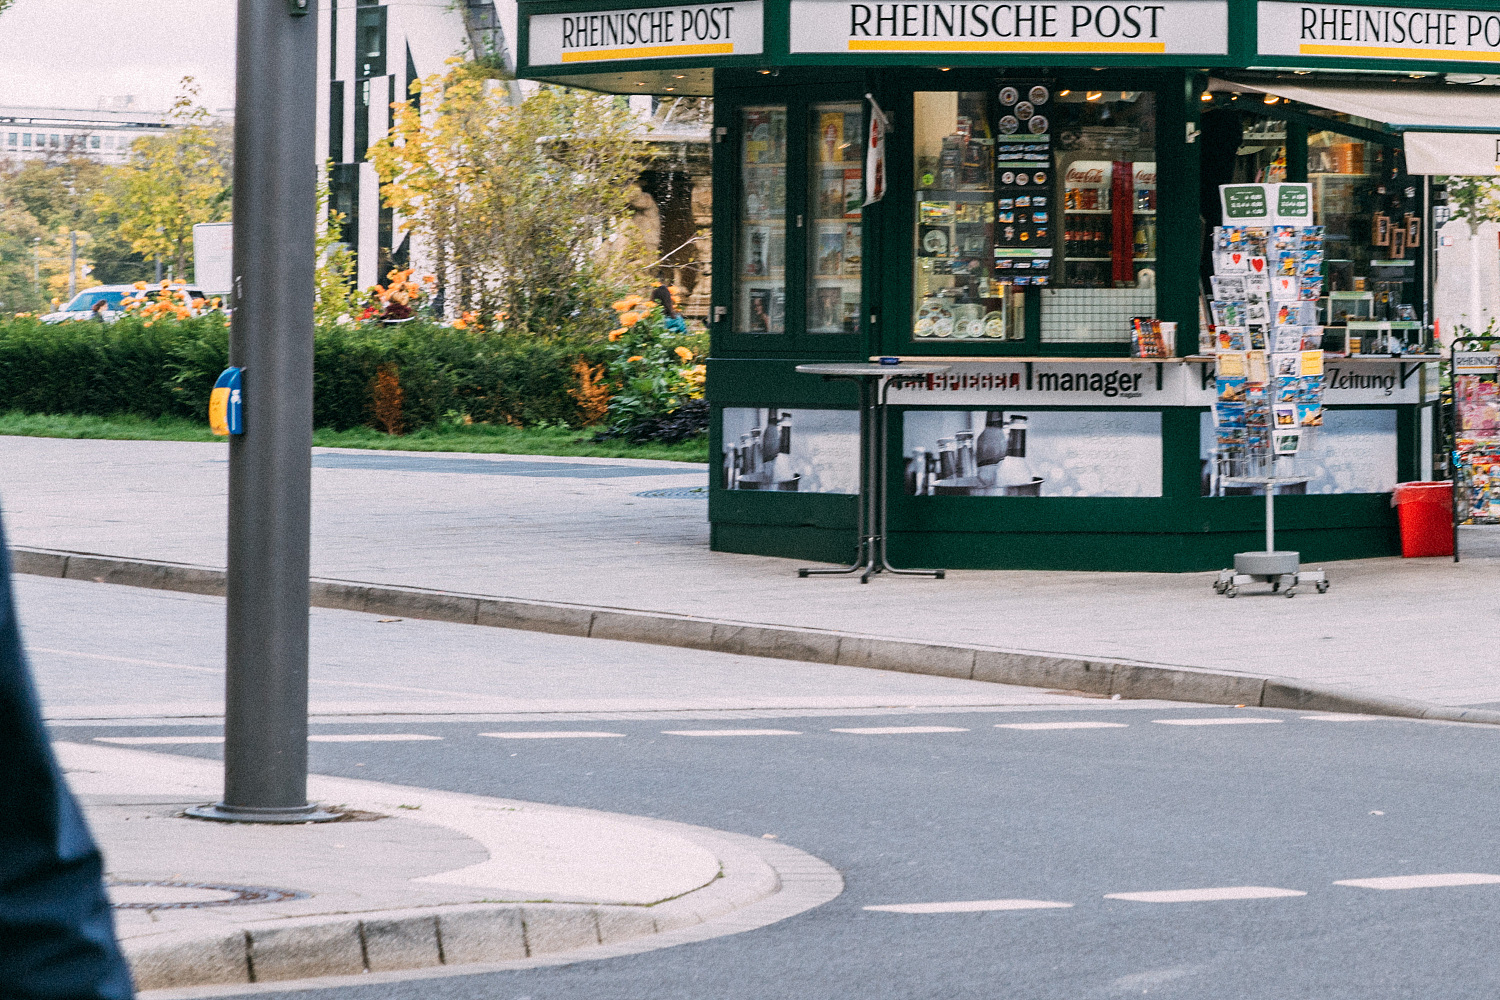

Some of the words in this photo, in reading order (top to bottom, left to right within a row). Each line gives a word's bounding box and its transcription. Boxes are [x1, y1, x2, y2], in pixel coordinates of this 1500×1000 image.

[562, 11, 674, 48] RHEINISCHE
[681, 7, 734, 41] POST
[850, 4, 1058, 38] RHEINISCHE
[1070, 5, 1165, 38] POST
[1300, 7, 1457, 45] RHEINISCHE
[1038, 369, 1142, 397] manager
[1327, 368, 1397, 396] Zeitung
